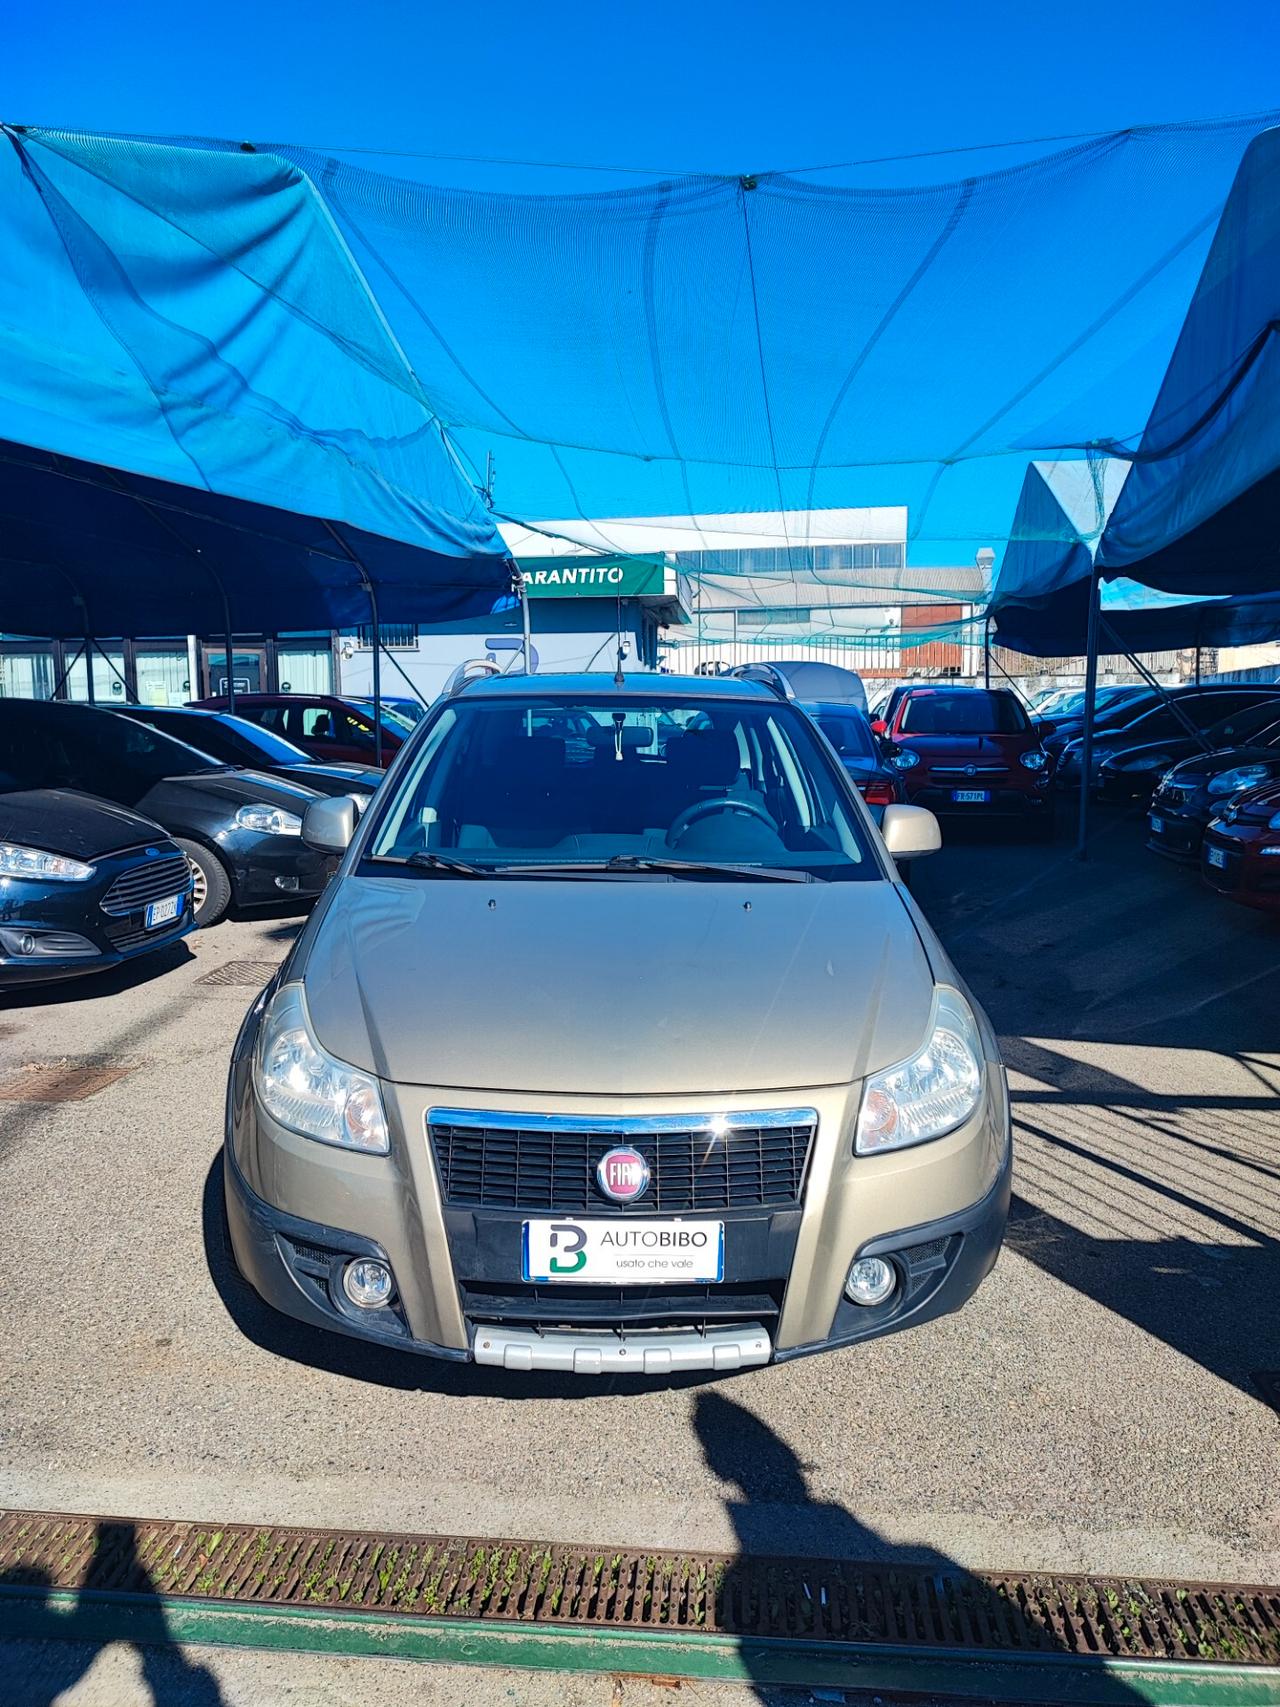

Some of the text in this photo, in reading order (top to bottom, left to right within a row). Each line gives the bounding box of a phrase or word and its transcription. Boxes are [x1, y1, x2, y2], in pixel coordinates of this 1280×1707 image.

[521, 567, 624, 585] ARANTITO
[600, 1231, 707, 1247] AUTOBIBO
[616, 1259, 694, 1269] usato che vale
